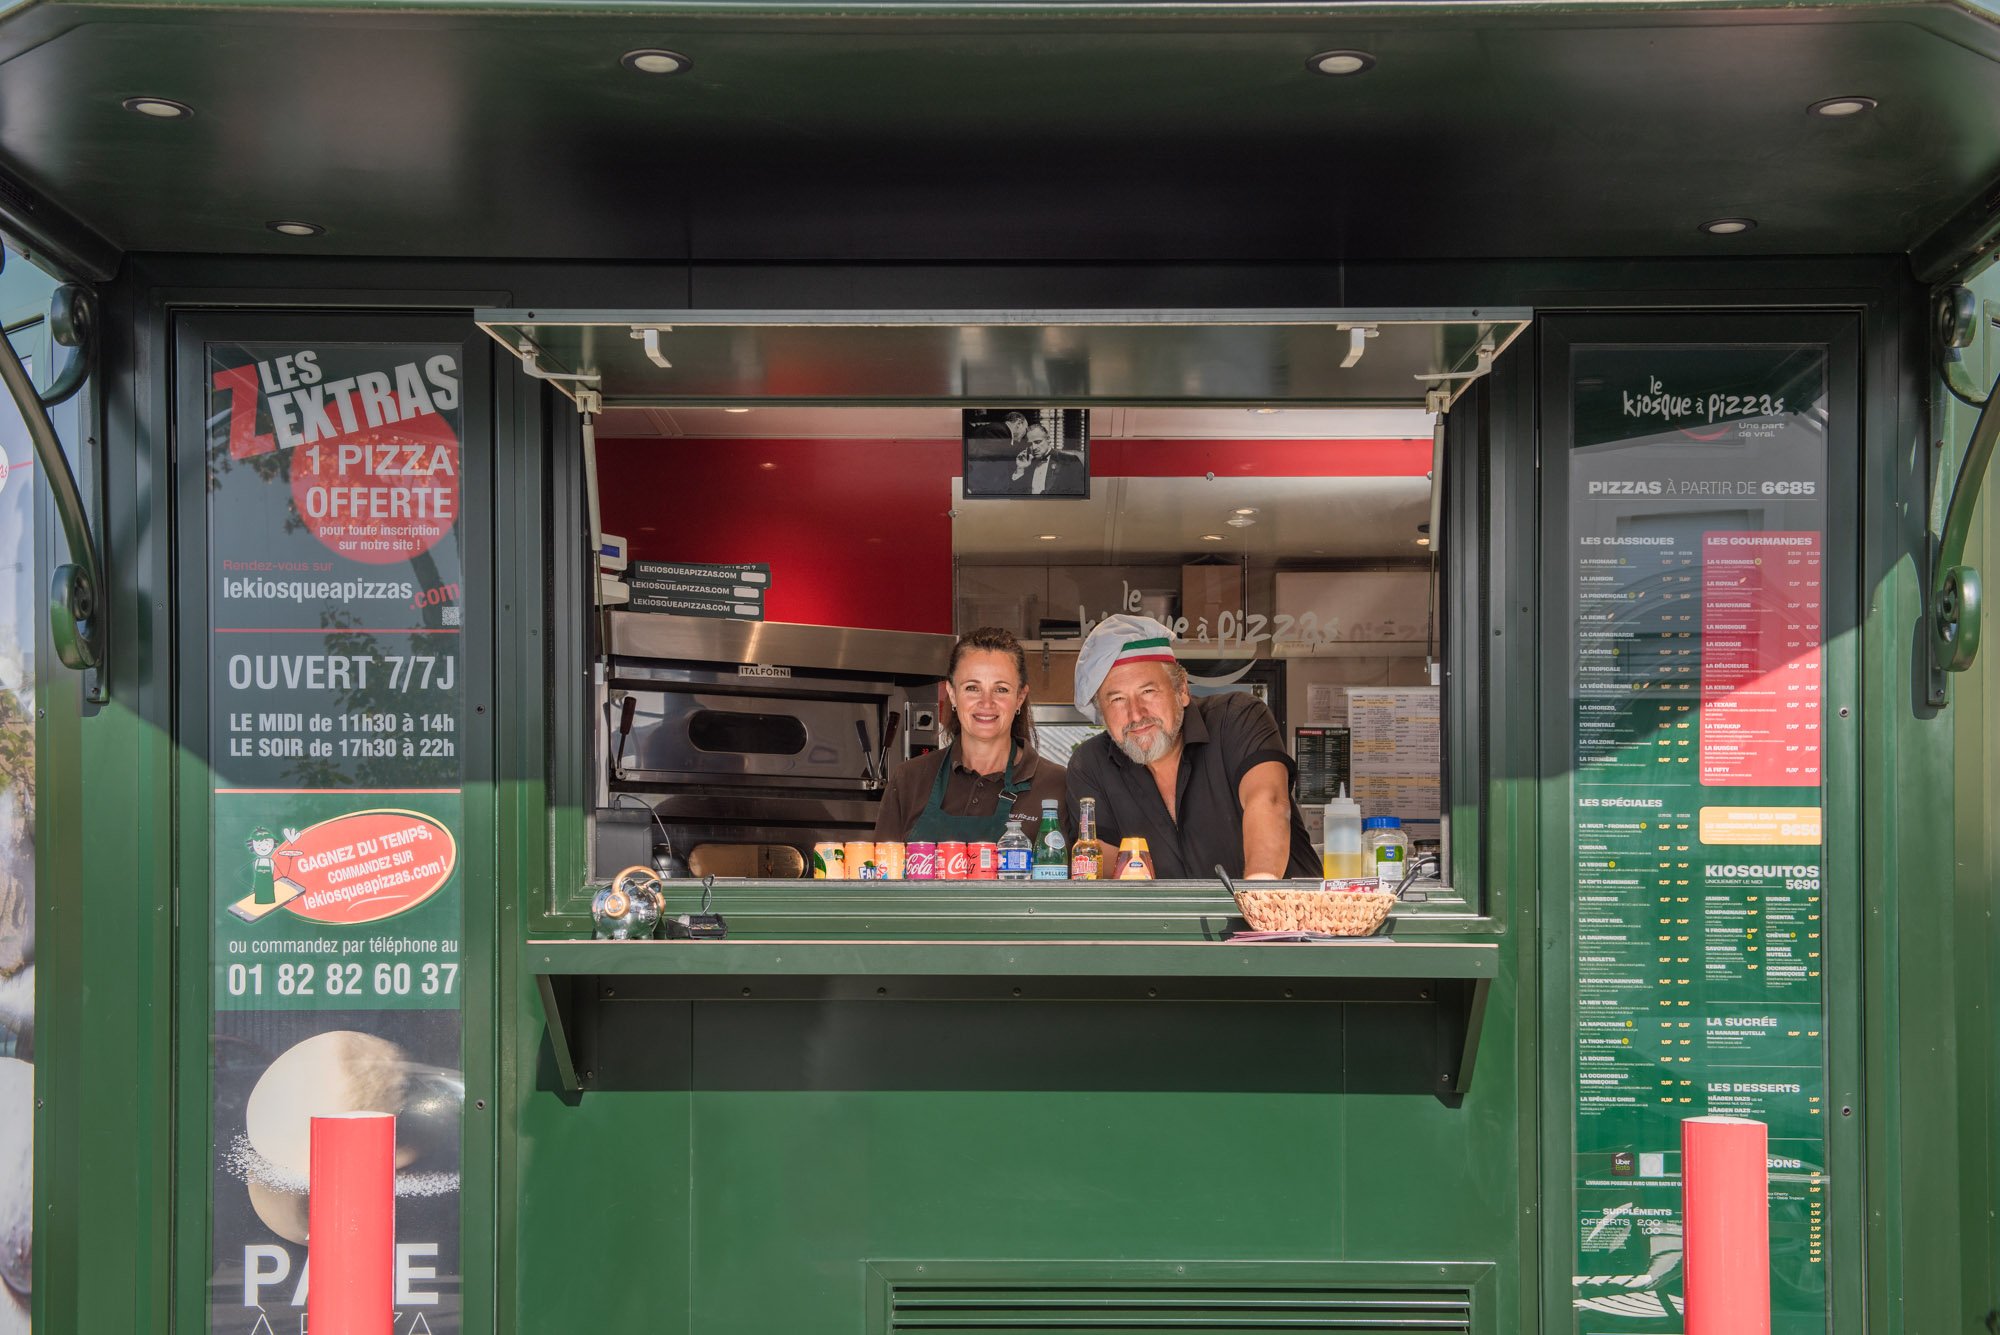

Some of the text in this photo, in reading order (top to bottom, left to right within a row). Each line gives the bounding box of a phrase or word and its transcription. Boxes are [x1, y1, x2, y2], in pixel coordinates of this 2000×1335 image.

[258, 350, 322, 394] LES
[1650, 375, 1662, 395] le
[267, 354, 459, 450] EXTRAS
[1623, 390, 1785, 423] kiosque à pizzas
[1738, 430, 1752, 438] de
[1761, 422, 1784, 431] part
[305, 444, 455, 476] 1 PIZZA
[1588, 478, 1816, 495] PIZZAS À PARTIR DE 6€85
[306, 486, 452, 518] OFFERTE
[319, 524, 440, 538] pour toute inscription
[338, 541, 358, 551] sur
[360, 540, 390, 551] notre
[392, 539, 413, 551] site
[1580, 537, 1675, 545] LES CLASSIQUES
[1707, 537, 1813, 546] LES GOURMANDES
[223, 559, 334, 571] Rendez-vous sur
[639, 564, 737, 580] LEKIOSQUEAPIZZAS.COM
[632, 580, 730, 595] LEKIOSQUEAPIZZAS.COM
[1122, 580, 1142, 612] le
[633, 597, 730, 612] LEKIOSQUEAPIZZAS.COM
[1196, 616, 1210, 644] à
[1217, 609, 1339, 657] pizzas
[228, 654, 455, 694] OUVERT 7/7J
[740, 666, 790, 677] ITALFORNI
[230, 712, 455, 732] LE MIDI de 11h30 à 14h
[230, 737, 455, 757] LE SOIR de 17h30 à 22h
[1579, 797, 1663, 808] LES SPÉCIALES
[297, 825, 433, 873] GAGNEZ DU TEMPS,
[327, 850, 414, 884] COMMANDEZ SUR
[1705, 864, 1820, 878] KIOSQUITOS
[303, 863, 441, 910] lekiosqueapizzas.com
[1785, 879, 1820, 890] 5€90
[229, 937, 458, 956] ou commandez par téléphone au
[228, 963, 459, 996] 01 82 82 60 37
[1706, 1016, 1778, 1027] LA SUCRÉE
[1707, 1083, 1801, 1093] LES DESSERTS
[1767, 1159, 1802, 1168] SONS
[1602, 1206, 1672, 1216] SUPPLÉMENTS
[1581, 1218, 1631, 1226] OFFERTS
[244, 1232, 439, 1307] PE
